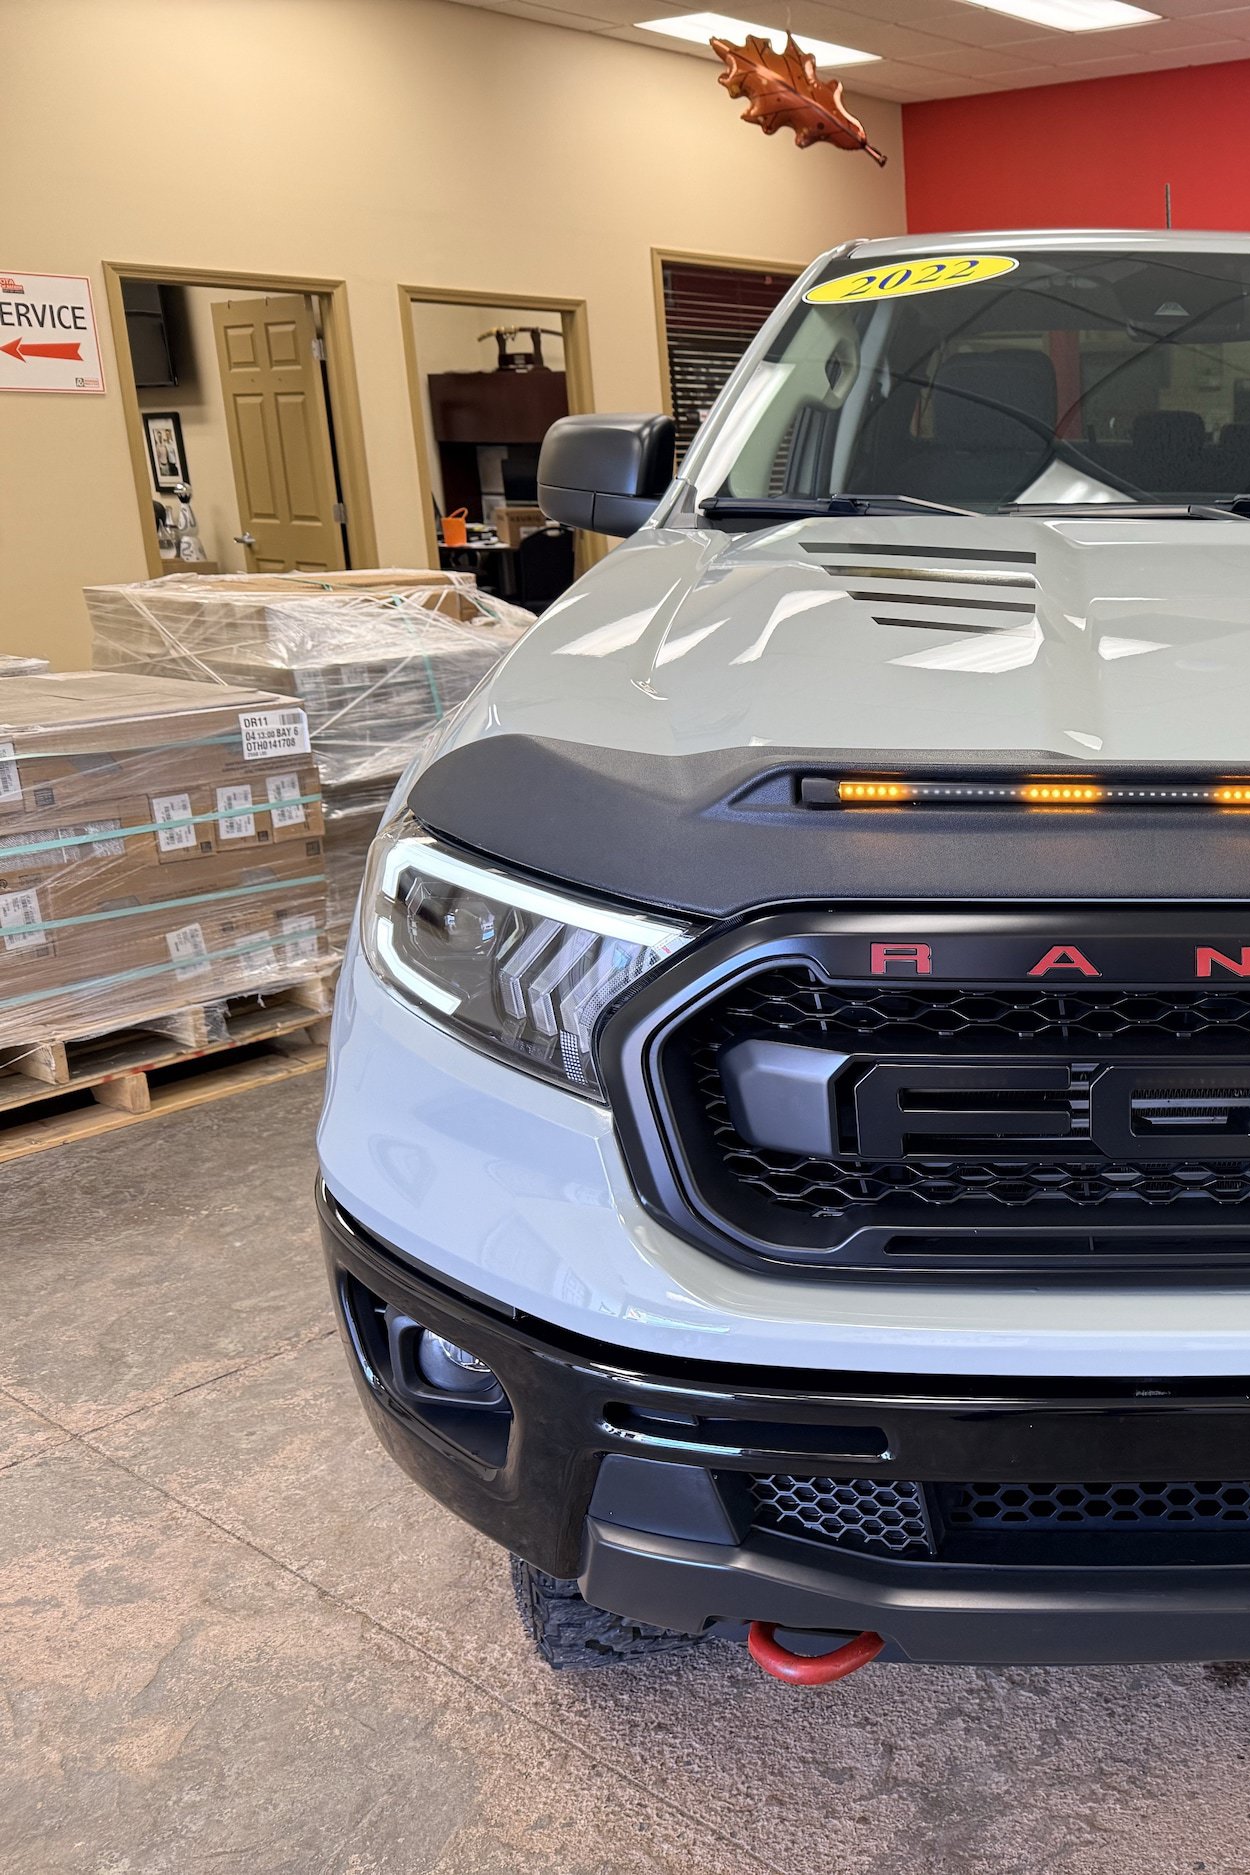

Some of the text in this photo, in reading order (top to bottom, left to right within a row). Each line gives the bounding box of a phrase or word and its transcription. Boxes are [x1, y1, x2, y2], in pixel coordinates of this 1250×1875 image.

[839, 260, 980, 299] 2022
[243, 717, 268, 728] DR11
[245, 731, 256, 741] 04
[276, 727, 291, 738] BAY
